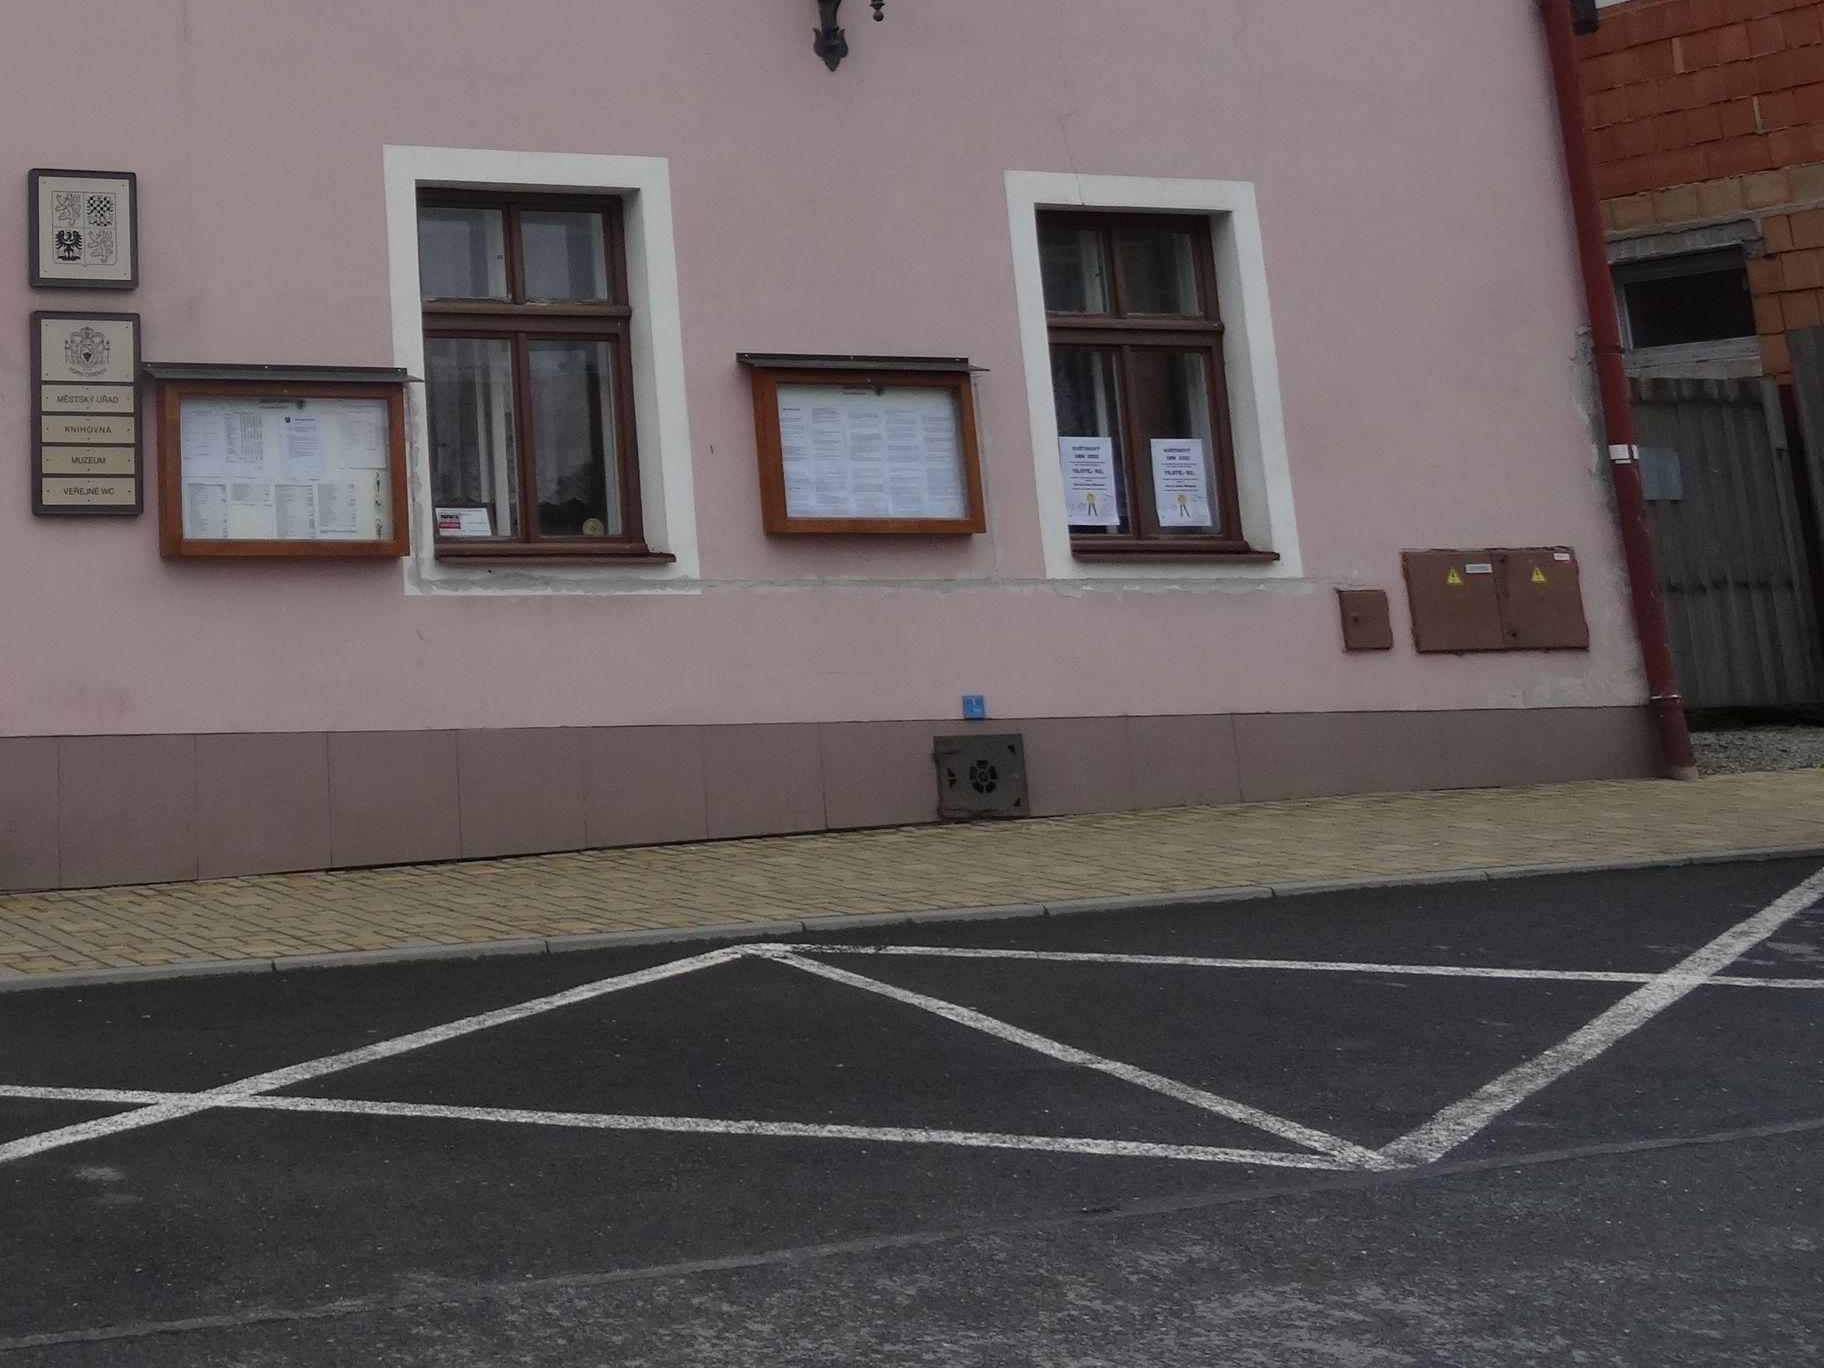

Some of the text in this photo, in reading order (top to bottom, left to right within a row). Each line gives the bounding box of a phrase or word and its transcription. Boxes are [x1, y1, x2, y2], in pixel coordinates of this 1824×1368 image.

[64, 425, 112, 434] KNIHOVNA
[71, 456, 107, 465] MUZEUM
[101, 487, 115, 496] WC
